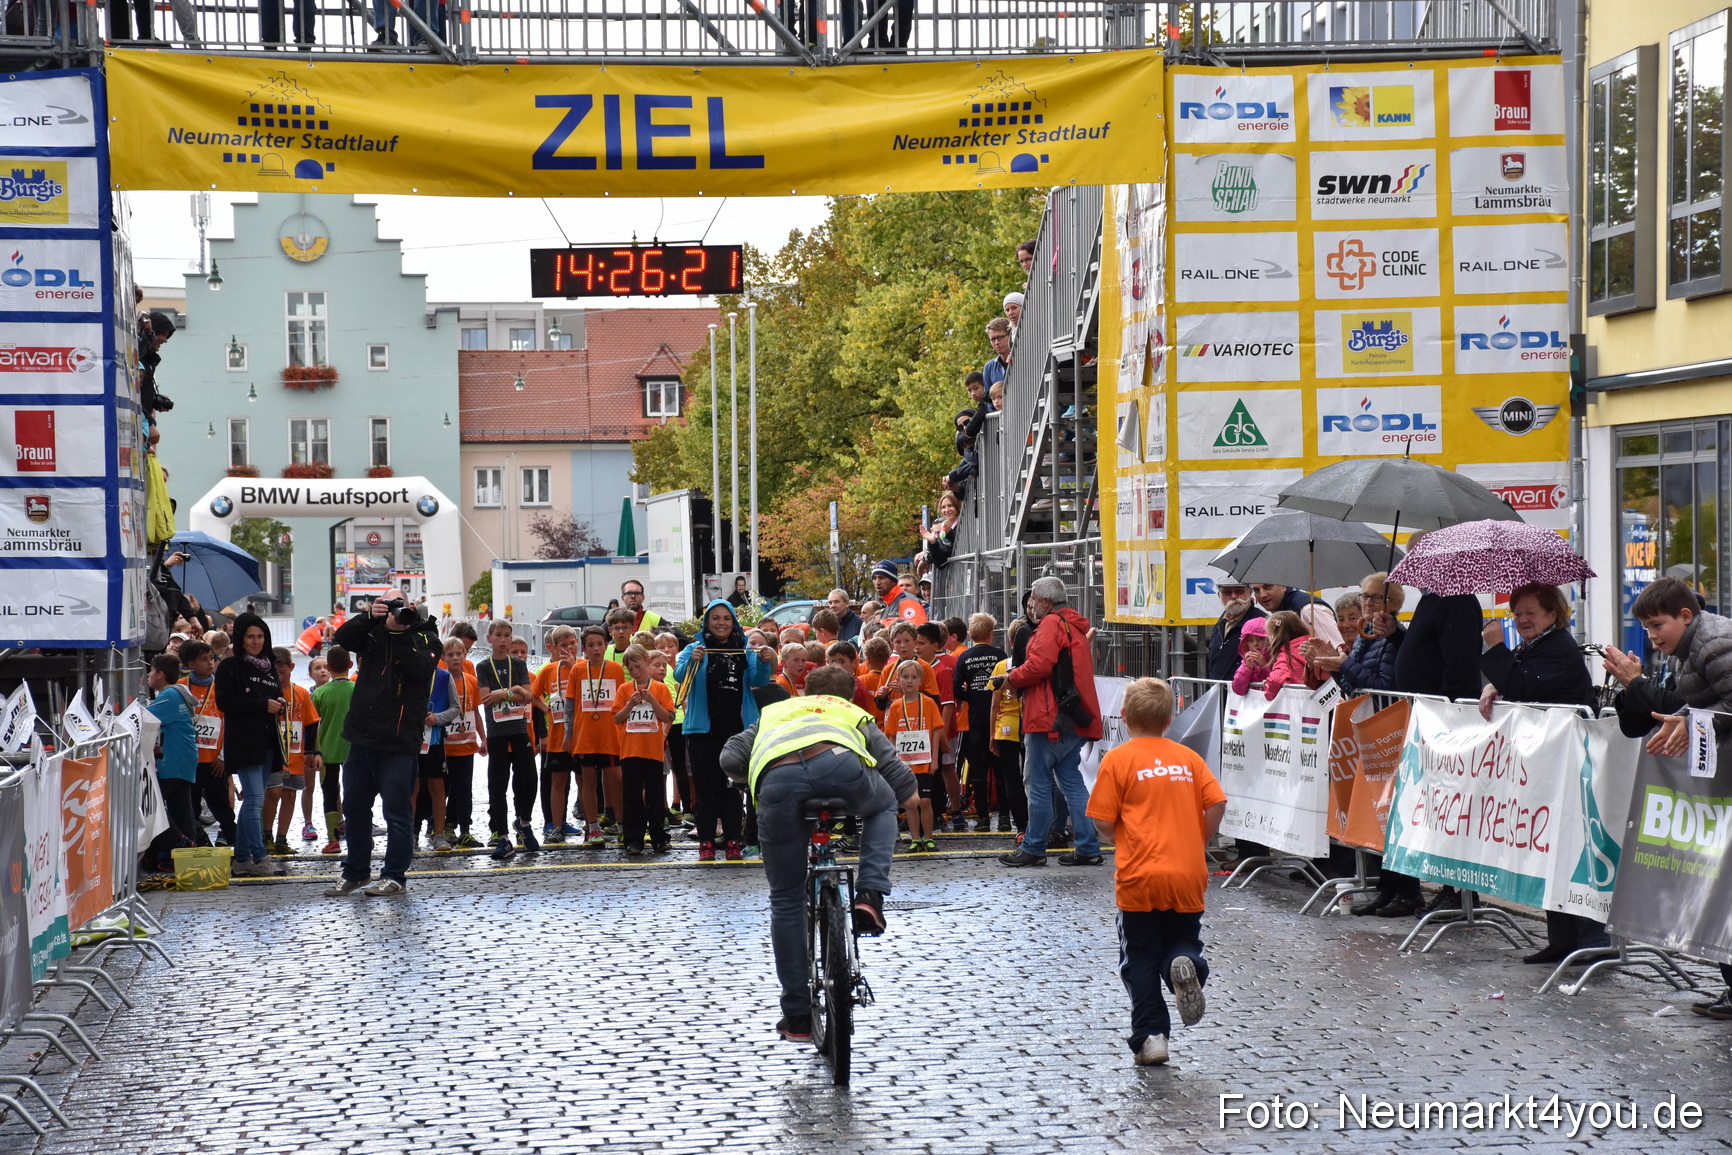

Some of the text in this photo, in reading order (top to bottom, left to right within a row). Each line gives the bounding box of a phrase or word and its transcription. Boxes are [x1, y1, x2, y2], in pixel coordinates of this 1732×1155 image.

[1377, 113, 1411, 123] KANN
[1494, 104, 1528, 119] Braun
[1238, 118, 1289, 130] energie
[532, 94, 765, 170] ZIEL
[892, 121, 1111, 150] Neumarkter Stadtlauf
[167, 127, 399, 153] Neumarkter Stadtlauf
[1213, 161, 1254, 188] RUND
[1317, 174, 1392, 195] swn
[1485, 185, 1542, 195] Neumarkter
[1213, 188, 1260, 211] SCHAU
[1316, 195, 1412, 205] stadtwerke neumarkt
[1474, 194, 1552, 209] Lammsbräu
[1382, 250, 1420, 263] CODE
[1382, 263, 1427, 276] CLINIC
[35, 286, 94, 299] energie
[1348, 329, 1409, 352] Burgis
[1213, 342, 1295, 357] VARIOTEC
[1521, 347, 1567, 361] energie
[1503, 410, 1532, 422] MINI
[1382, 428, 1437, 442] energie
[15, 444, 52, 460] Braun
[240, 486, 409, 508] BMW Laufsport
[7, 528, 71, 537] Neumarkter
[631, 710, 655, 720] 7147
[900, 741, 926, 752] 7274
[1634, 846, 1670, 870] inspired
[1671, 853, 1682, 876] by
[1568, 889, 1583, 904] Jura
